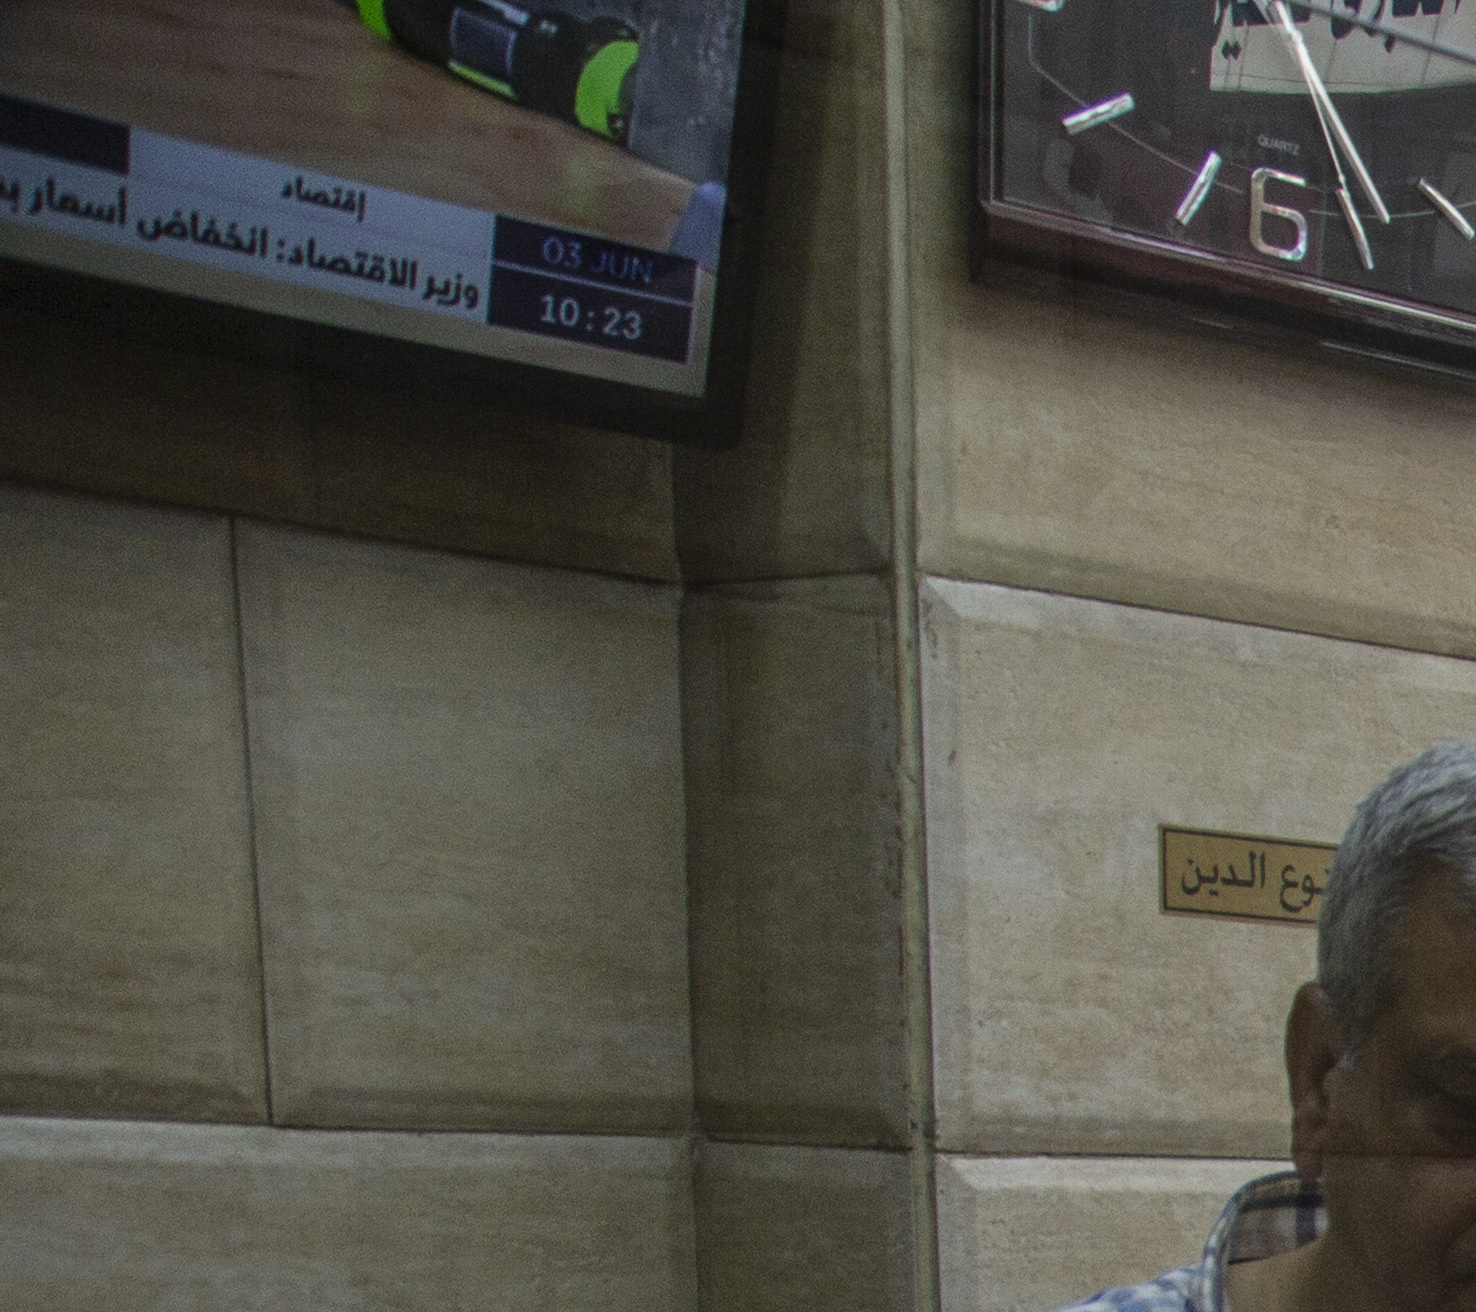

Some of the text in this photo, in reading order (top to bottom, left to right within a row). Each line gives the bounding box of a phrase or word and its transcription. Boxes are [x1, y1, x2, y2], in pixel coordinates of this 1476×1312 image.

[27, 180, 129, 228] أسعار
[1250, 166, 1309, 262] 6
[137, 206, 269, 261] انخفاض
[541, 237, 654, 285] 03 JUN
[422, 269, 481, 312] وزير
[539, 293, 644, 342] 10:23
[1180, 849, 1267, 898] الدين
